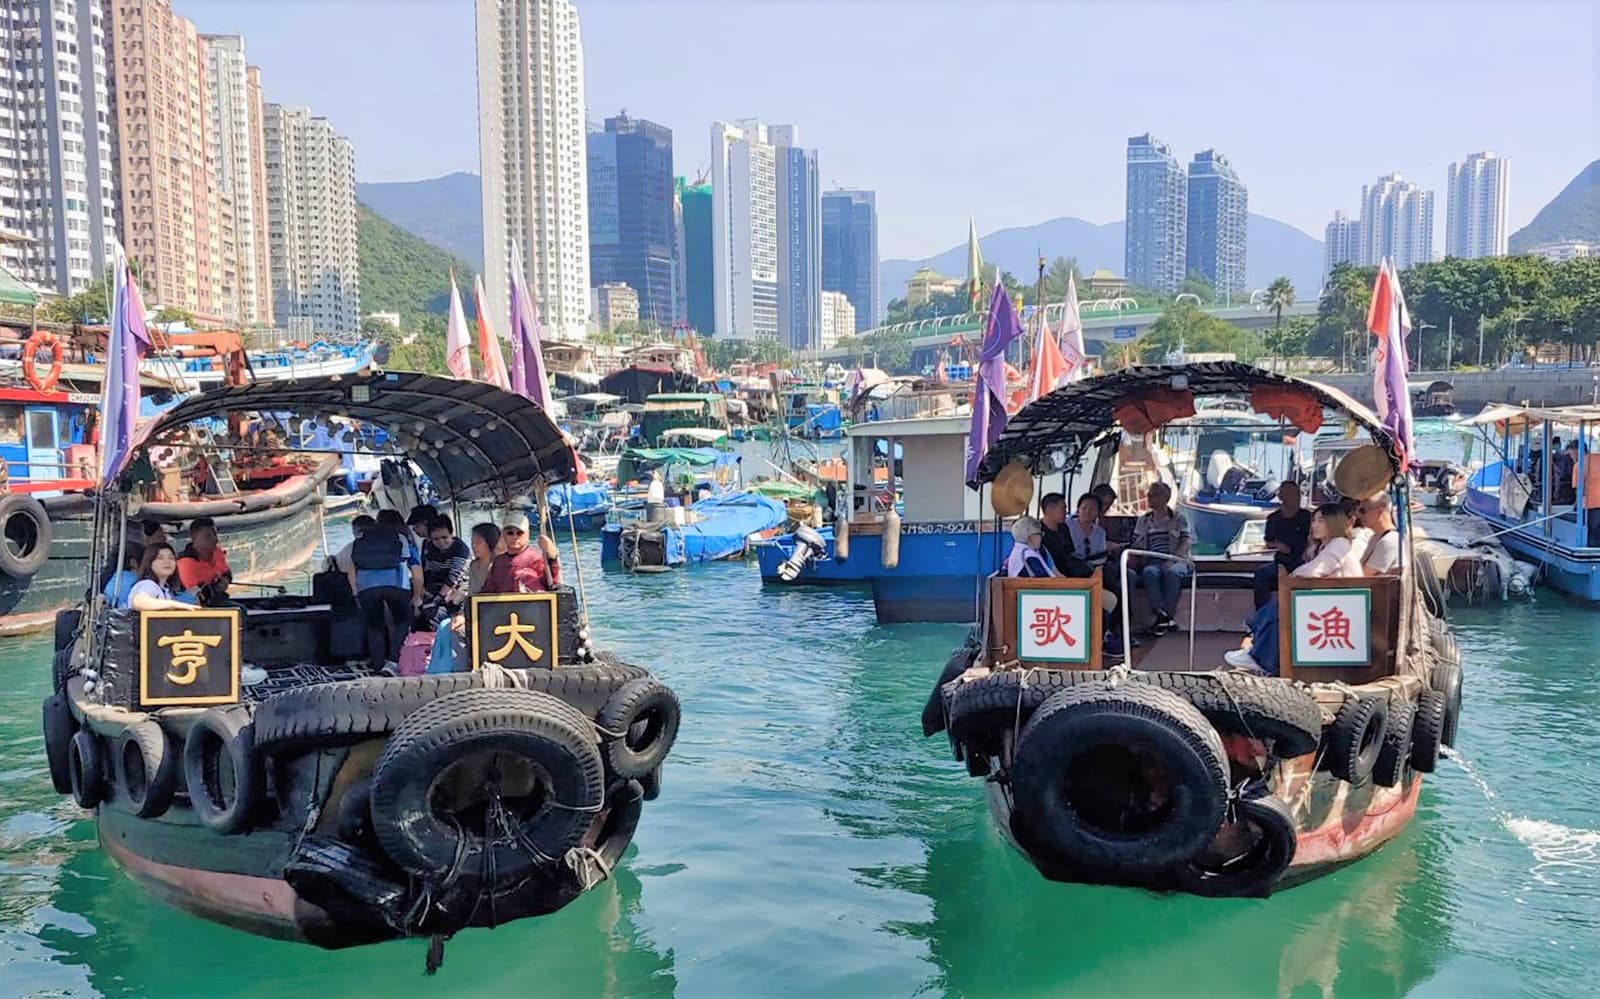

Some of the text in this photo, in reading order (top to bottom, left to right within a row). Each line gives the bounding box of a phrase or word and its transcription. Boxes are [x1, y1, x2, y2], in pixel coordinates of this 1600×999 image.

[487, 612, 545, 662] 大
[1030, 605, 1077, 647] 歌
[1307, 606, 1356, 650] 漁
[157, 629, 223, 686] 亨
